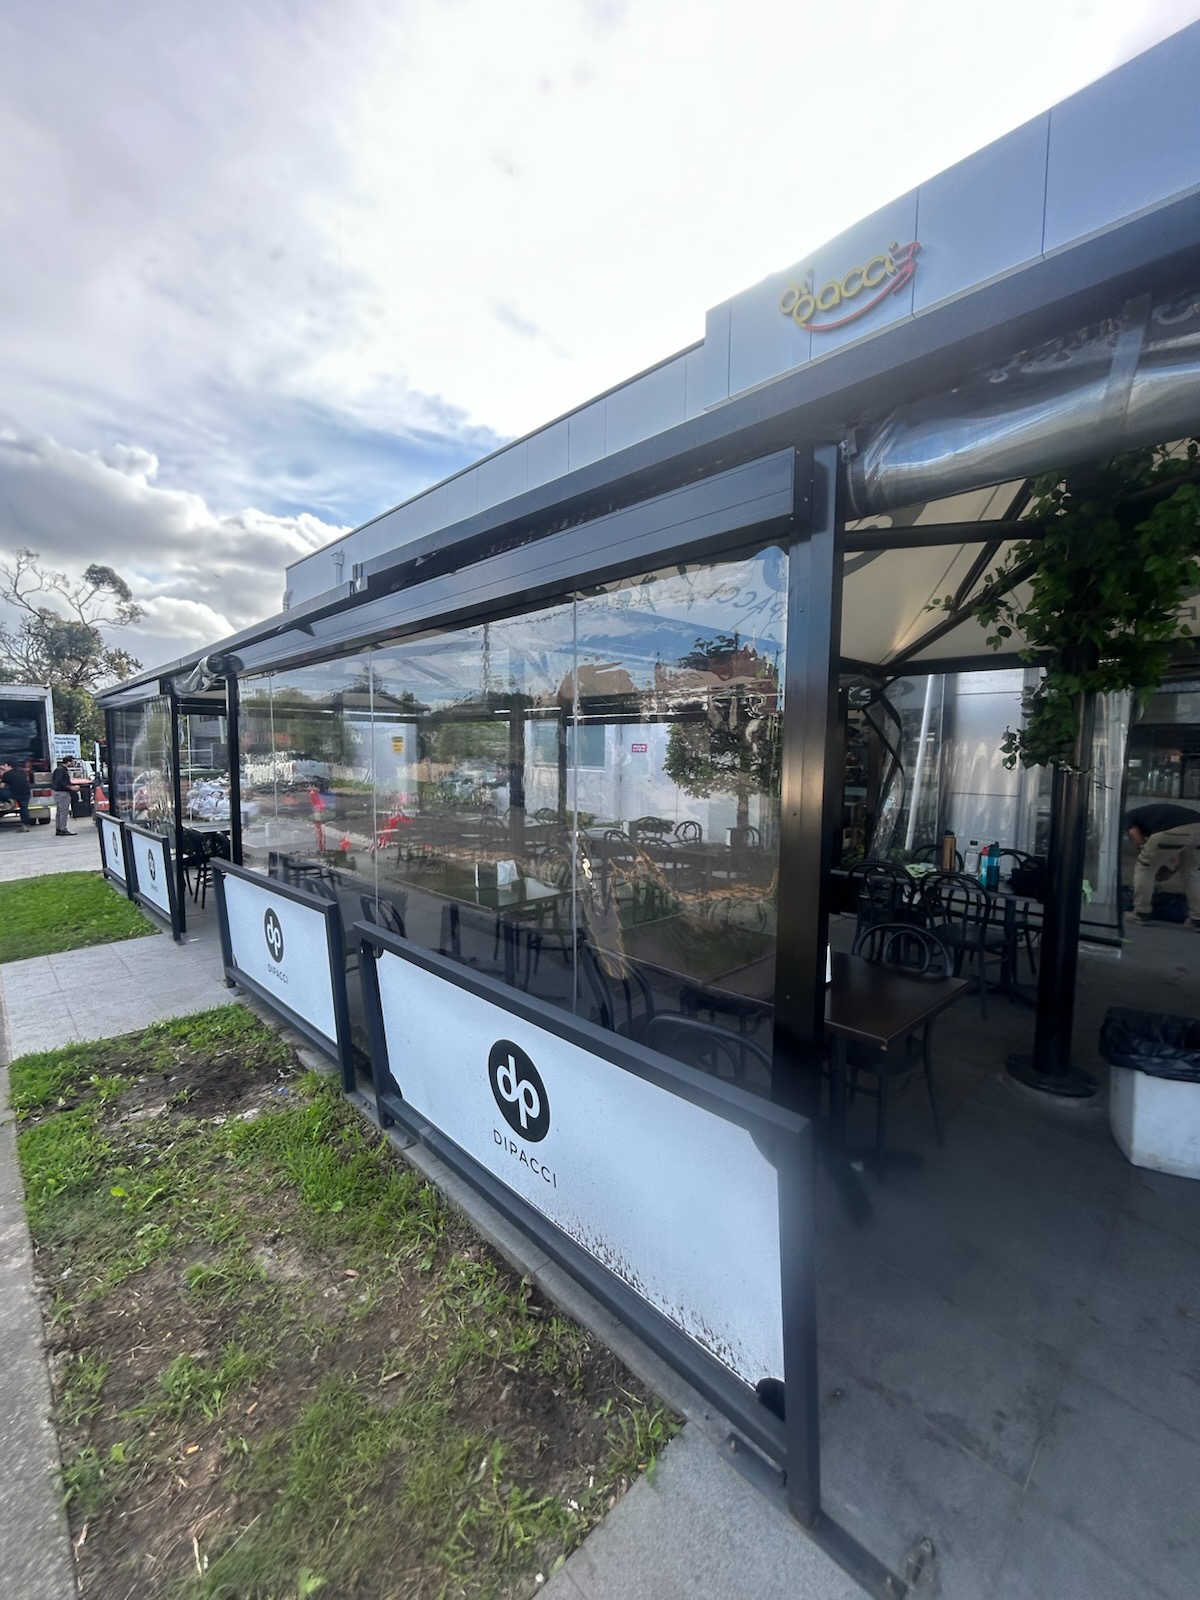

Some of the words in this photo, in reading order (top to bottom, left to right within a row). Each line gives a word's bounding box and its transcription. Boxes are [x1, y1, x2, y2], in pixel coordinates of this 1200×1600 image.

[267, 915, 281, 957] dp
[267, 963, 289, 985] DIPACCI
[496, 1053, 541, 1130] dp
[493, 1128, 557, 1189] DIPACCI
